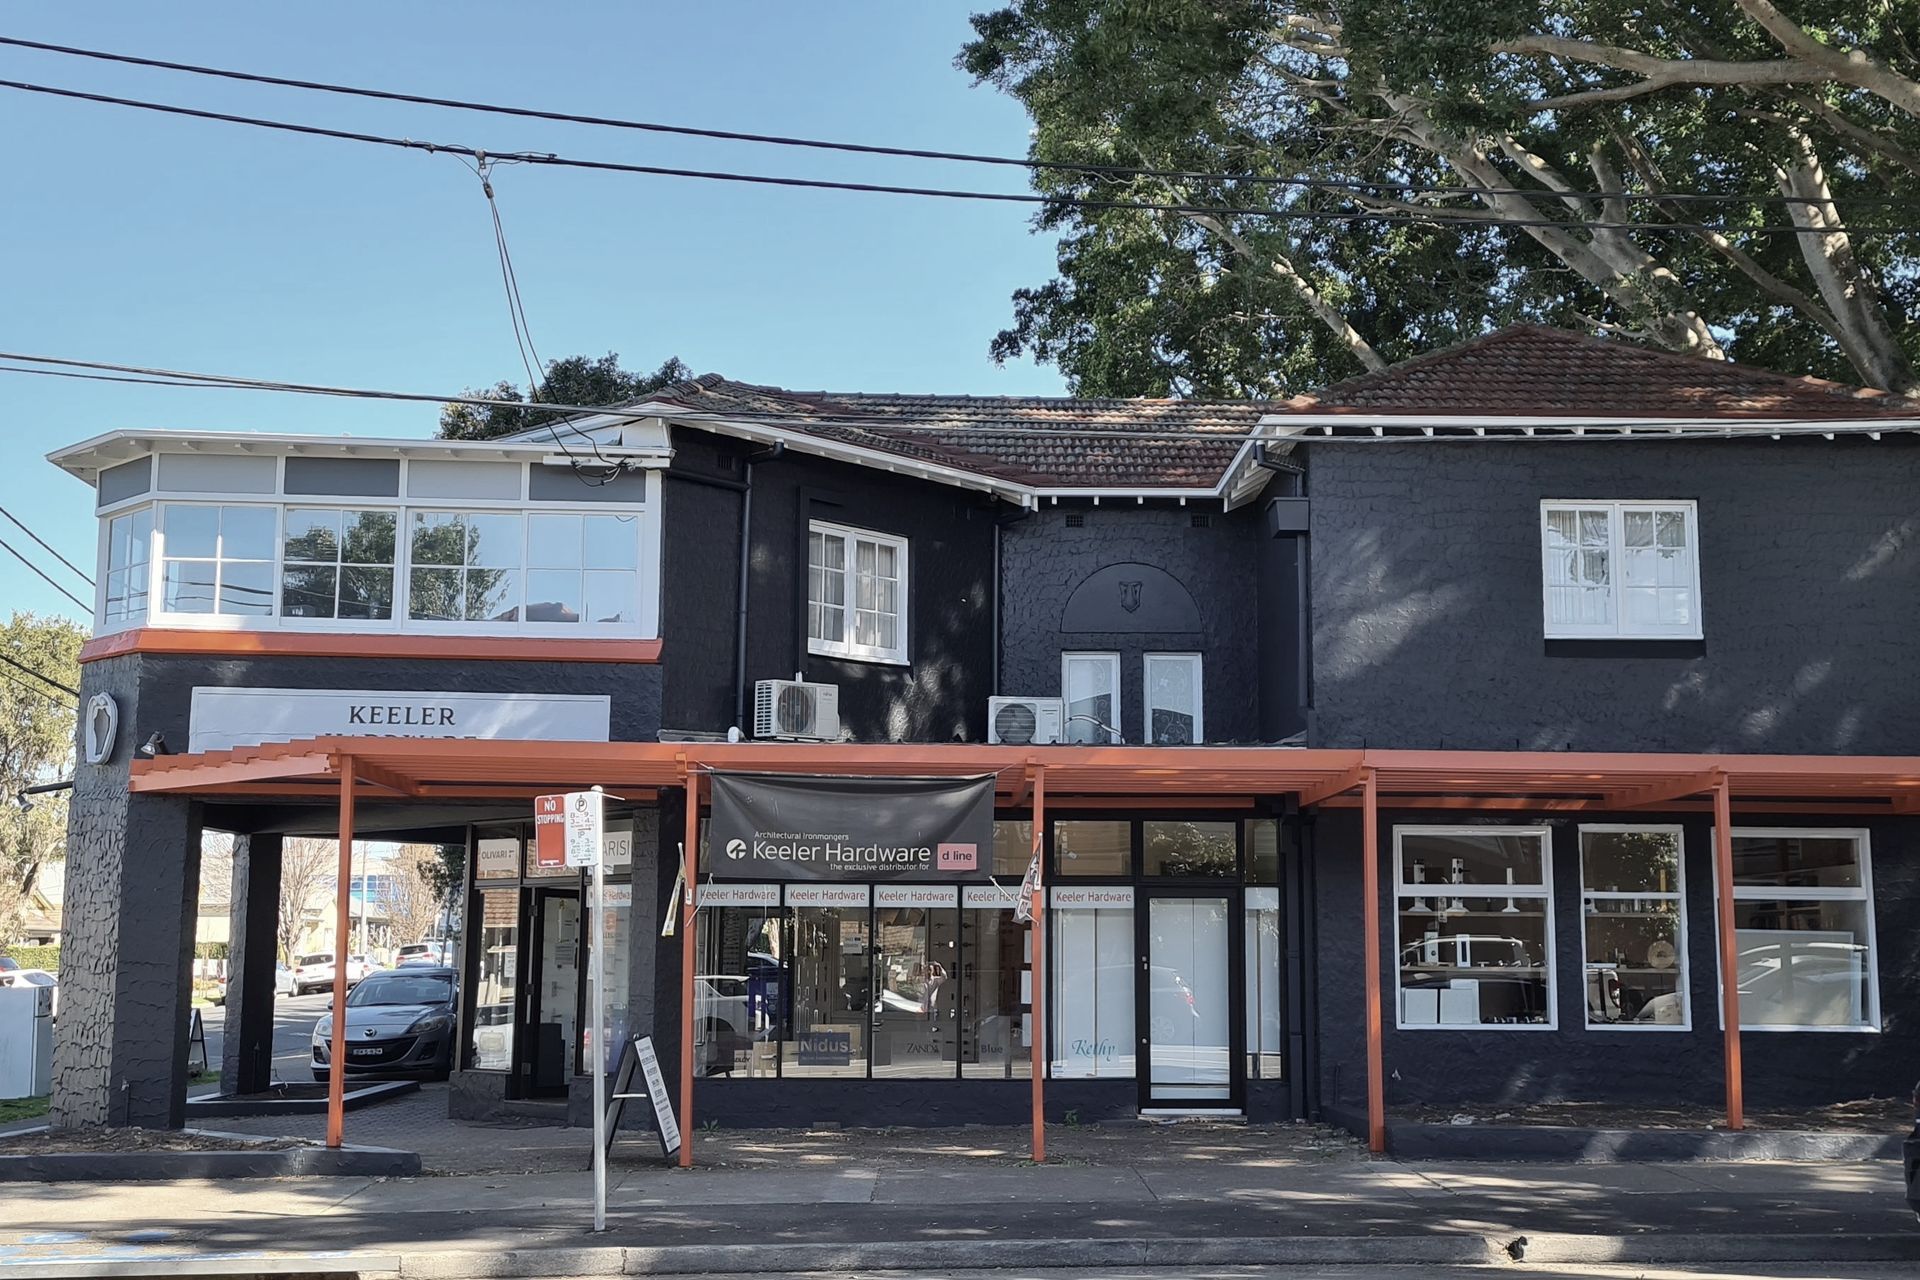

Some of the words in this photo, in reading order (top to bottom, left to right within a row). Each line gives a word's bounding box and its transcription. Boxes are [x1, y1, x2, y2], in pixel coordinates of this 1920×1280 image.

[348, 705, 456, 725] KEELER
[544, 800, 556, 811] NO
[537, 814, 564, 825] STOPPING
[754, 831, 801, 840] Architectural
[803, 832, 849, 841] Ironmongers
[603, 840, 630, 857] ARISI
[753, 841, 821, 860] Keeler
[825, 843, 931, 862] Hardware
[481, 850, 508, 860] OLIVARI
[953, 850, 973, 861] line
[844, 863, 877, 871] exclusive
[878, 863, 916, 871] distributor
[700, 889, 729, 900] Keeler
[732, 889, 777, 900] Hardware
[790, 889, 819, 901] Keeler
[822, 889, 866, 901] Hardware
[878, 890, 908, 902] Keeler
[910, 890, 955, 902] Hardware
[967, 891, 996, 902] Keeler
[1056, 891, 1085, 903] Keeler
[1088, 891, 1132, 903] Hardware
[800, 1038, 849, 1053] Nidus
[981, 1043, 1003, 1054] Blue
